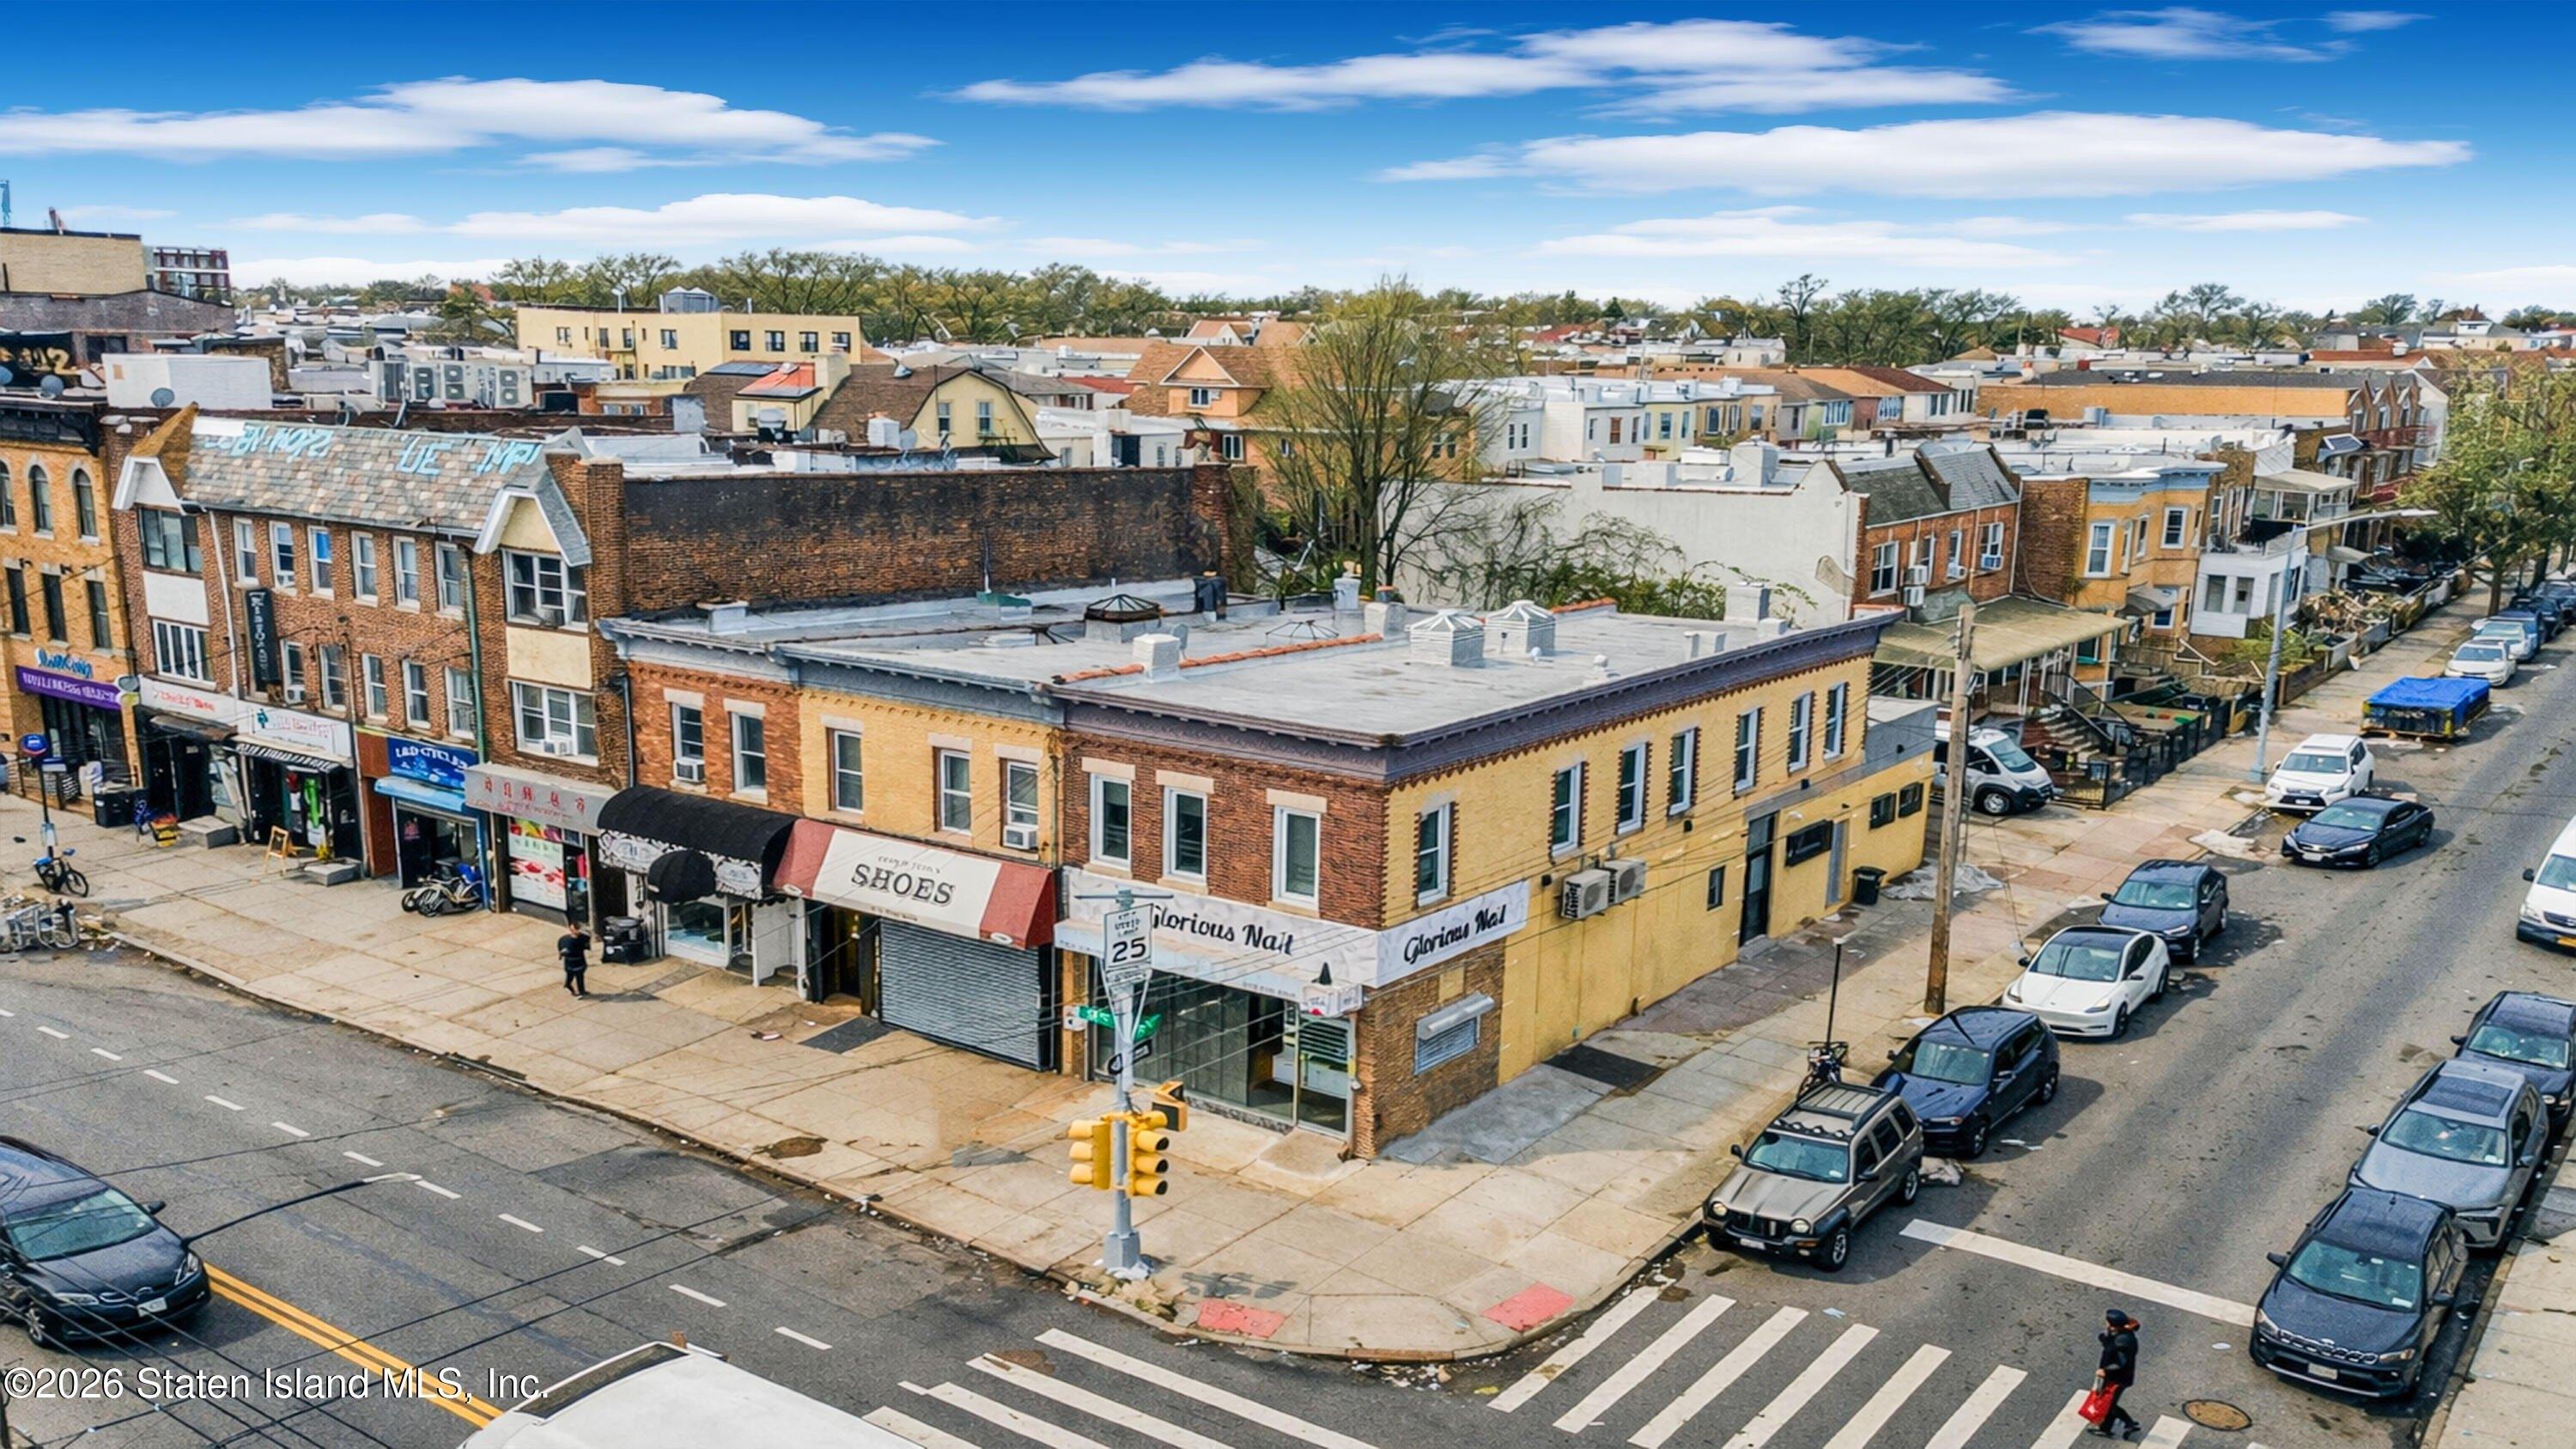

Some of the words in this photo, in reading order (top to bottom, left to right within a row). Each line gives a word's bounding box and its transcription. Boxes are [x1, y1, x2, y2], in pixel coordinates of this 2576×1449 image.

[851, 863, 955, 905] SHOES
[1112, 936, 1146, 963] 25
[1242, 923, 1293, 955] Nail
[1404, 922, 1469, 965] Glorious
[1474, 904, 1507, 935] Nail
